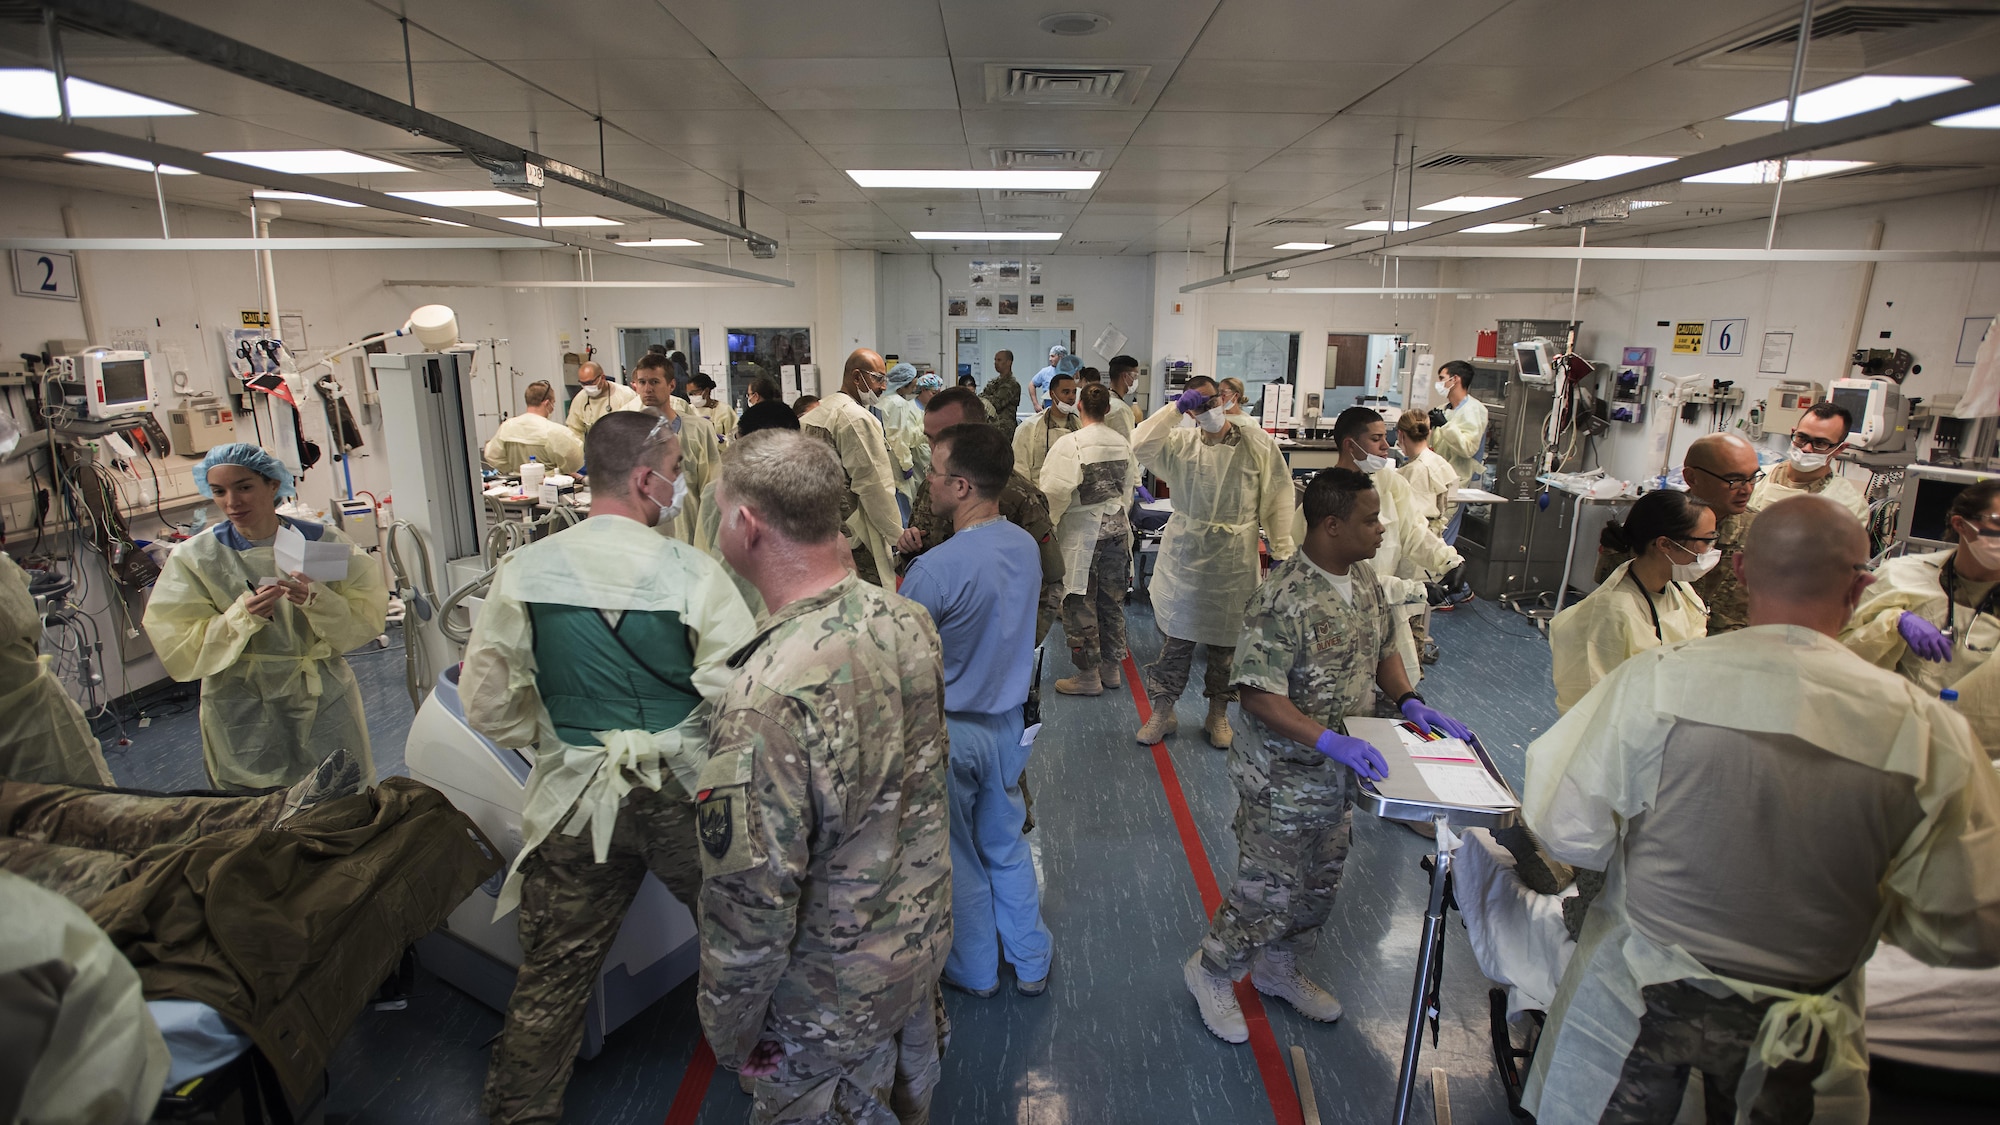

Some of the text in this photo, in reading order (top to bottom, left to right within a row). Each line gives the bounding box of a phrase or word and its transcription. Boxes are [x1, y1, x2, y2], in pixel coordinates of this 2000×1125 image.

[37, 256, 57, 292] 2
[1678, 324, 1703, 335] CAUTION
[1719, 323, 1734, 351] 6
